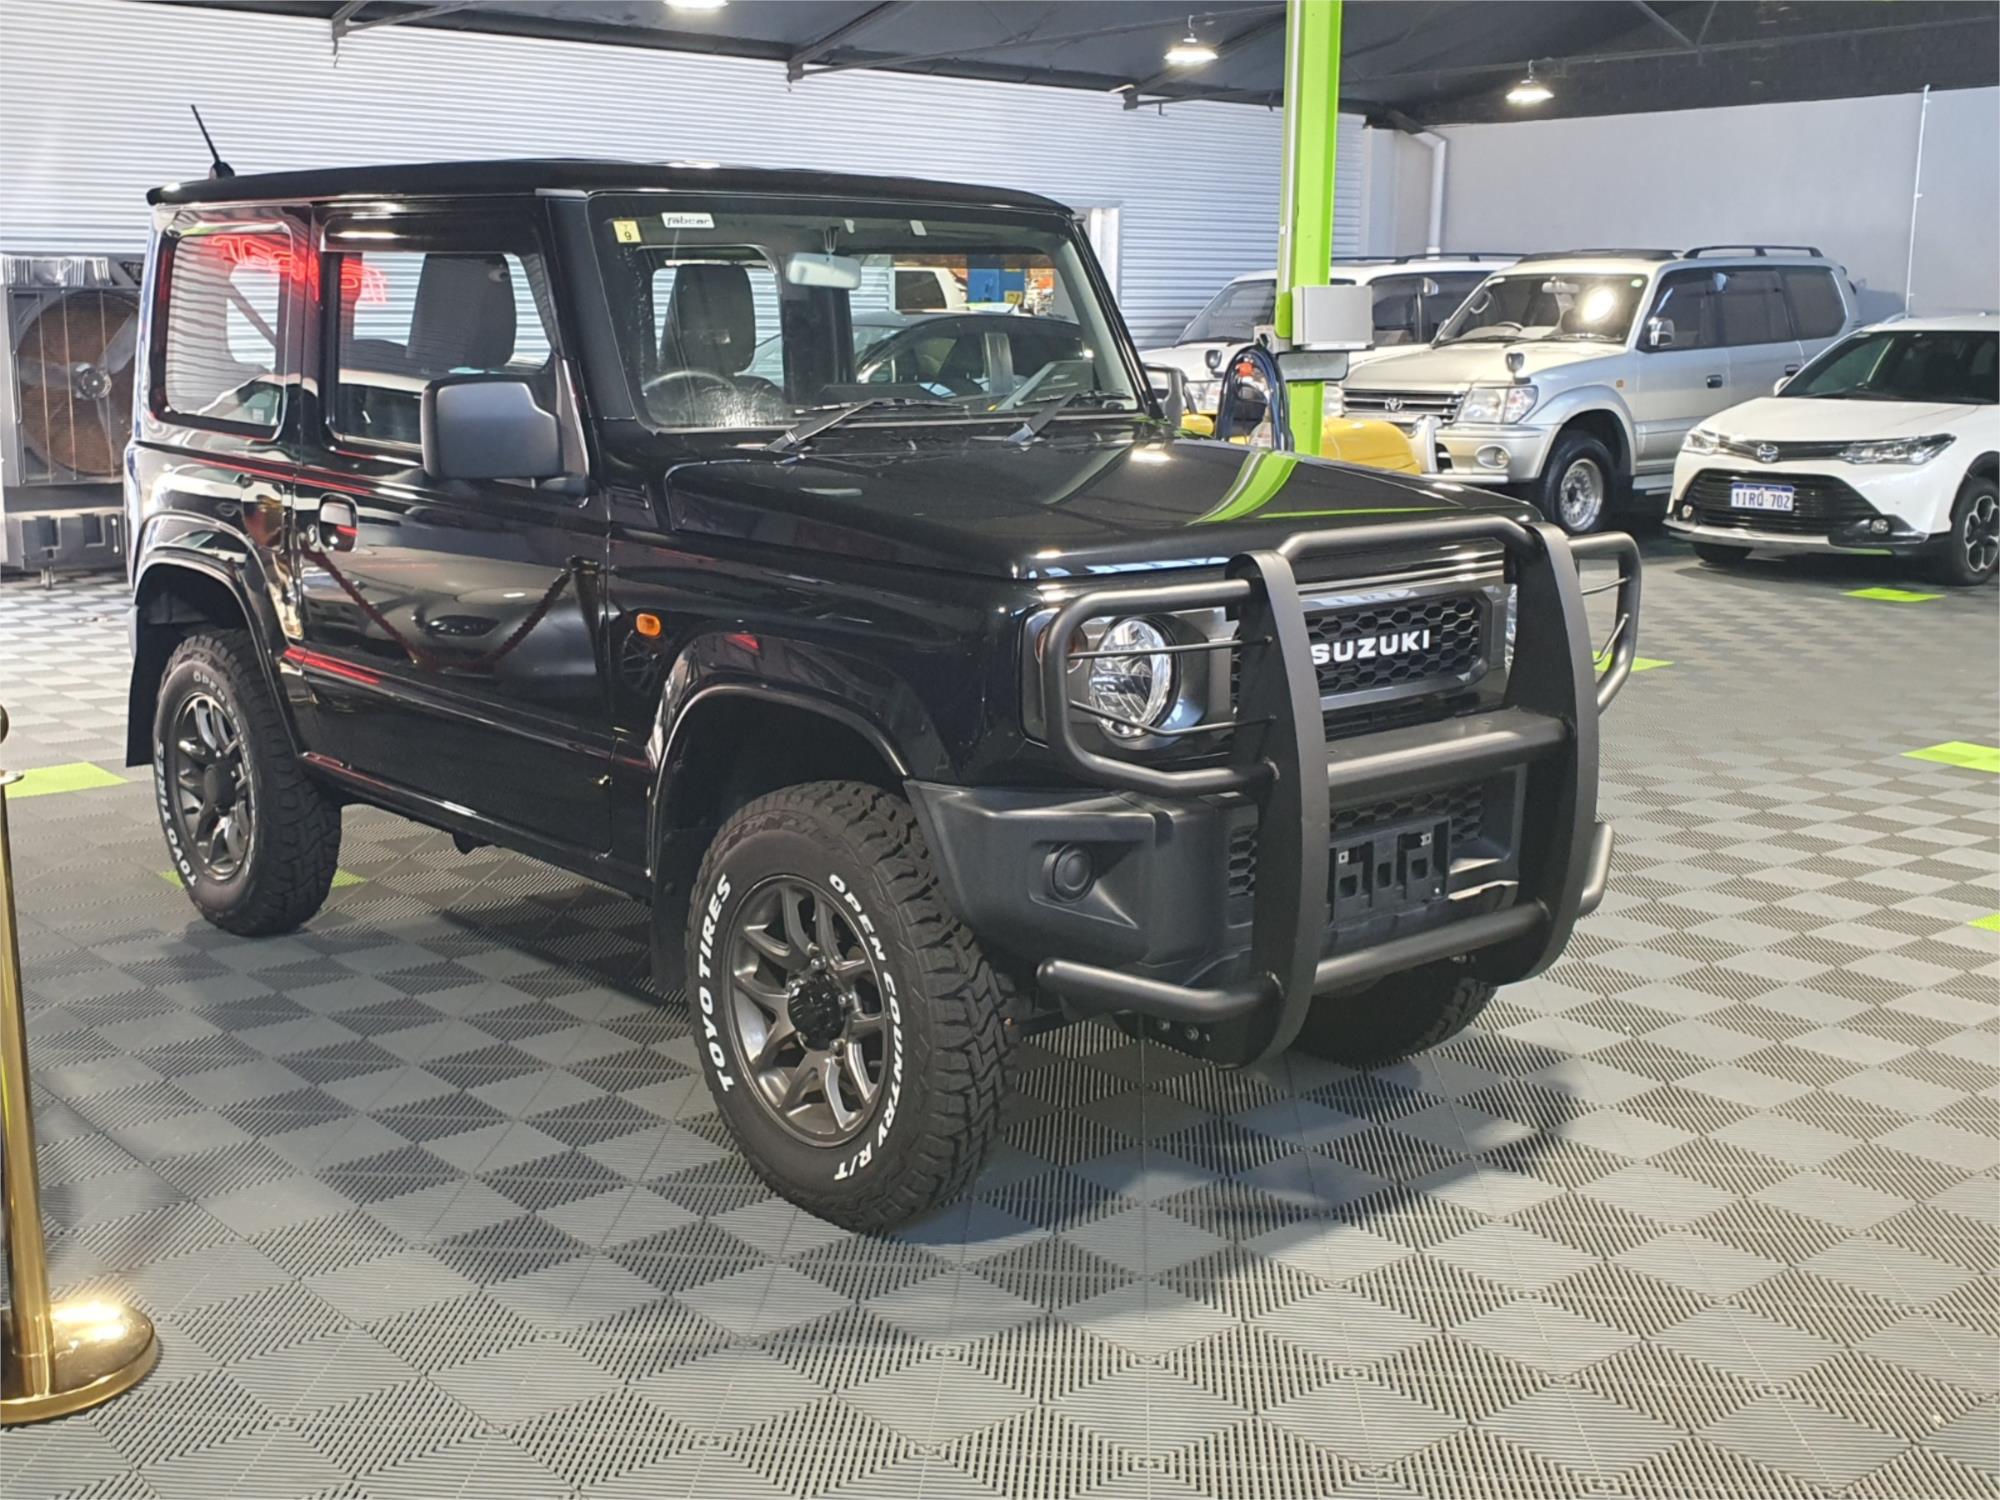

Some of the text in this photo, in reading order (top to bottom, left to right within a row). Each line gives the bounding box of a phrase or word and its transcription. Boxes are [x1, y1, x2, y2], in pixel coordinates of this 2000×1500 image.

[1310, 629, 1430, 665] SUZUKI
[167, 827, 198, 887] TOYO
[698, 872, 736, 1093] TOYO TIRES
[828, 873, 904, 1181] OPEN COUNTRY R/T
